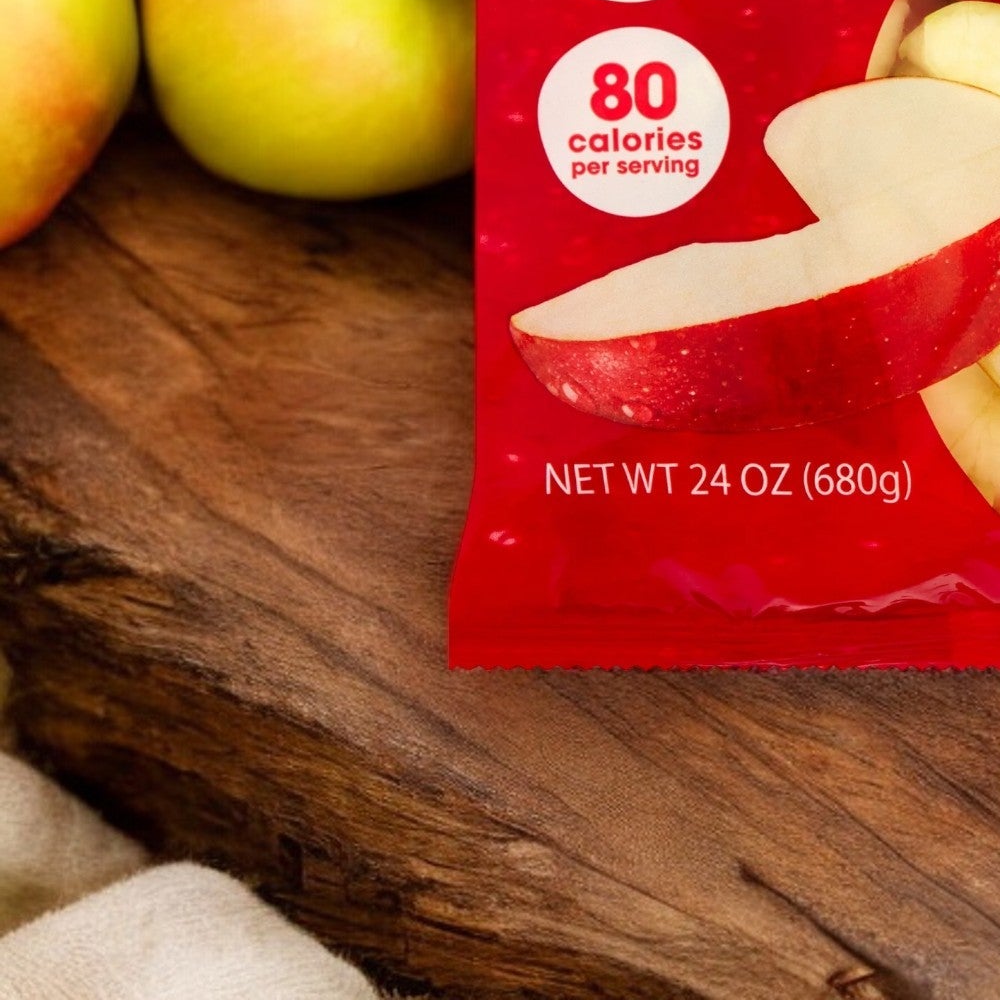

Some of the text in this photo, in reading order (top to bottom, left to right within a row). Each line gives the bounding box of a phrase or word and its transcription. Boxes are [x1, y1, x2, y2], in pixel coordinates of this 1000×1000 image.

[590, 61, 677, 121] 80
[568, 127, 703, 153] calories
[571, 156, 700, 179] per serving
[545, 460, 912, 503] NET WT 24 OZ (680g)
